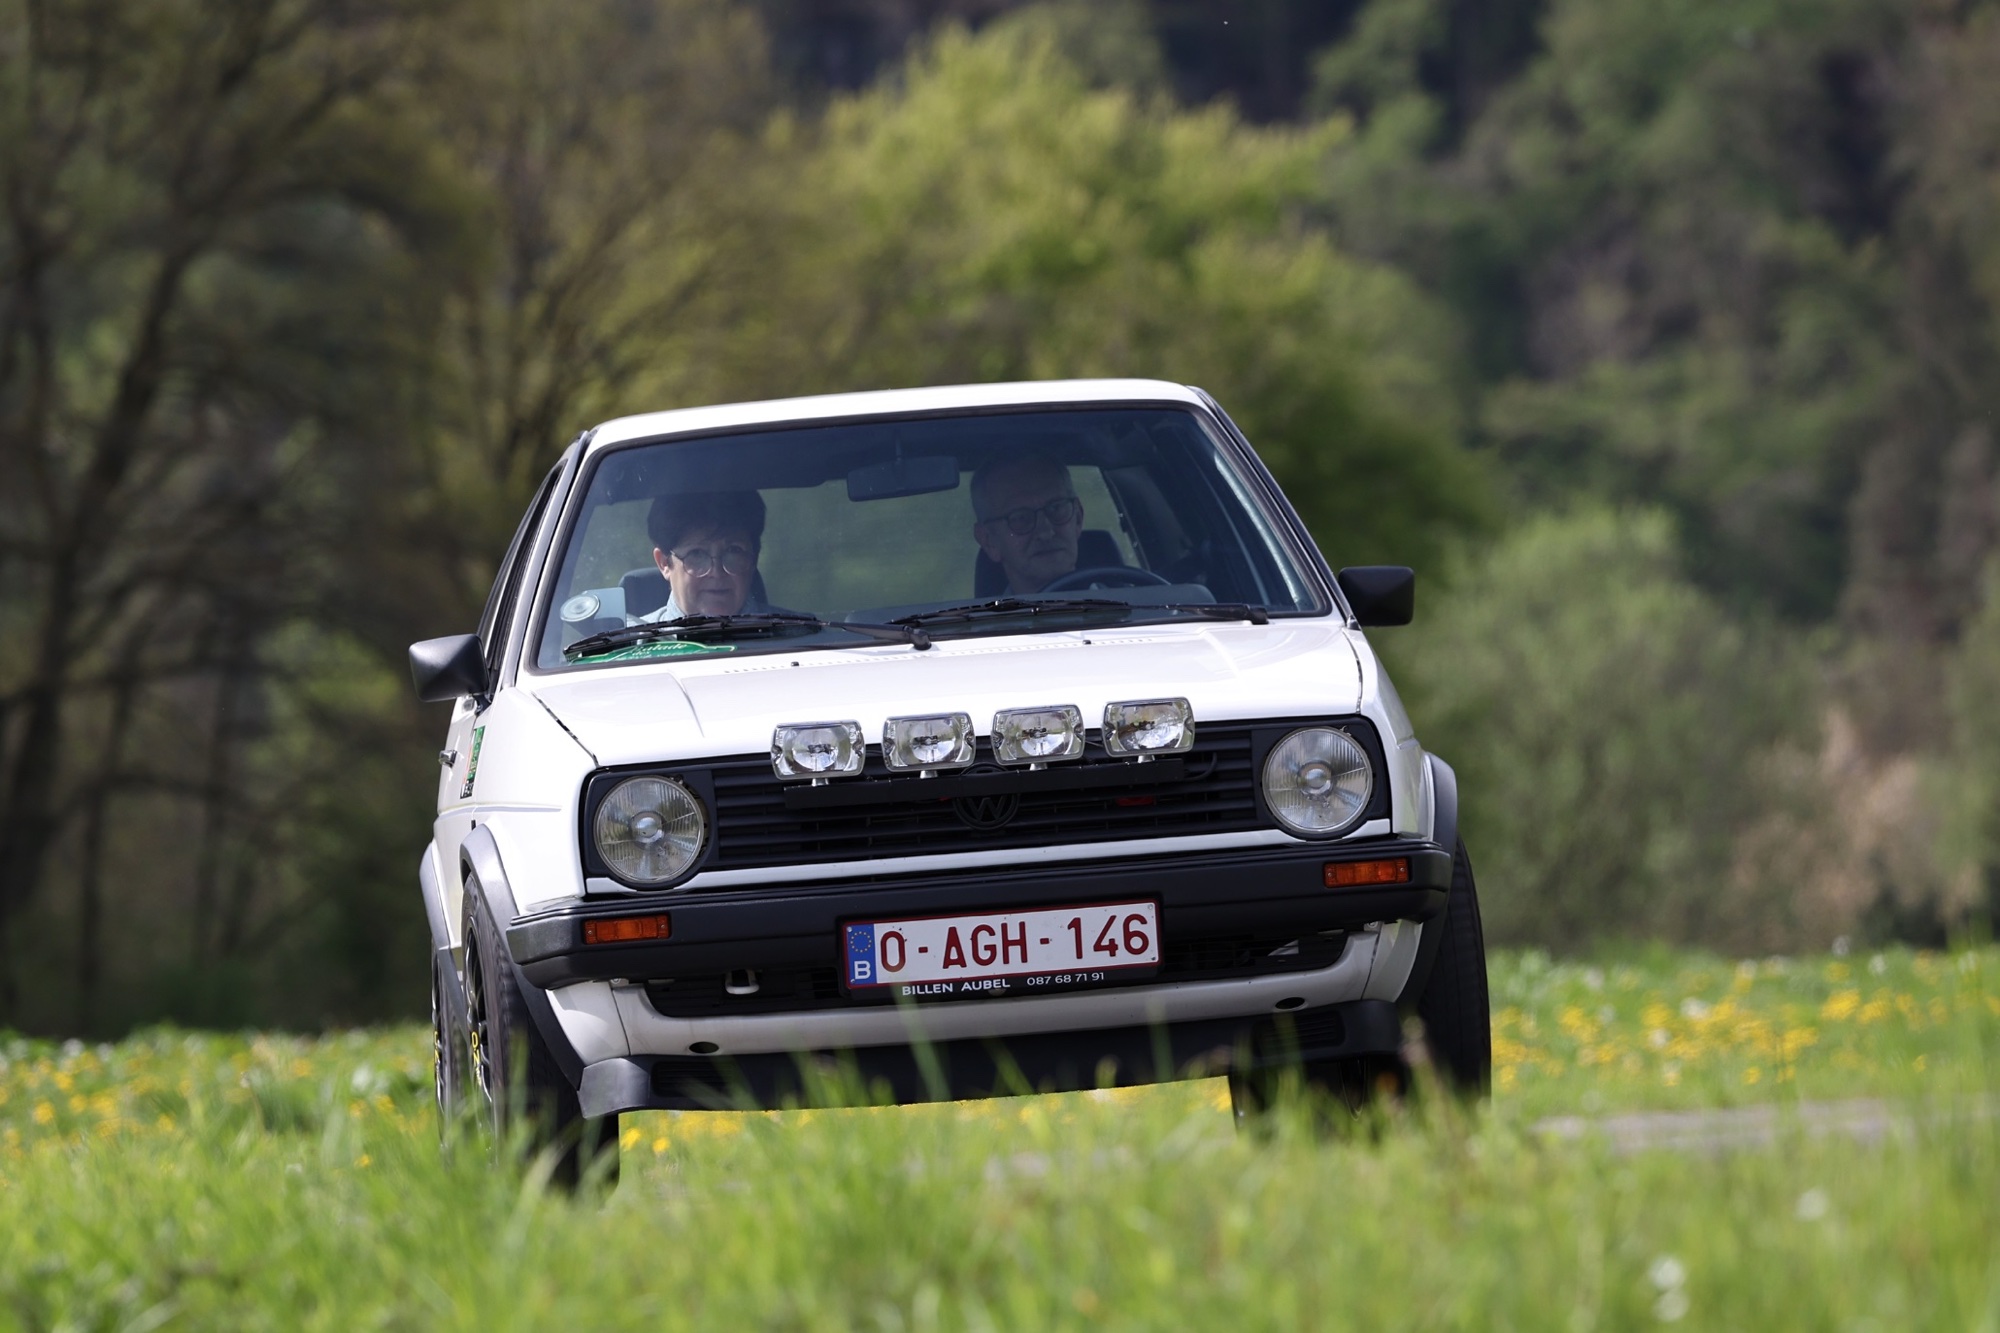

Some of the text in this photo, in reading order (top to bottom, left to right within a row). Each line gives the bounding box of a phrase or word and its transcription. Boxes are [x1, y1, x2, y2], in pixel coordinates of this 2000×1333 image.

[854, 960, 871, 980] B
[902, 972, 1104, 996] BILLEN AUBEL 087 68 71 91
